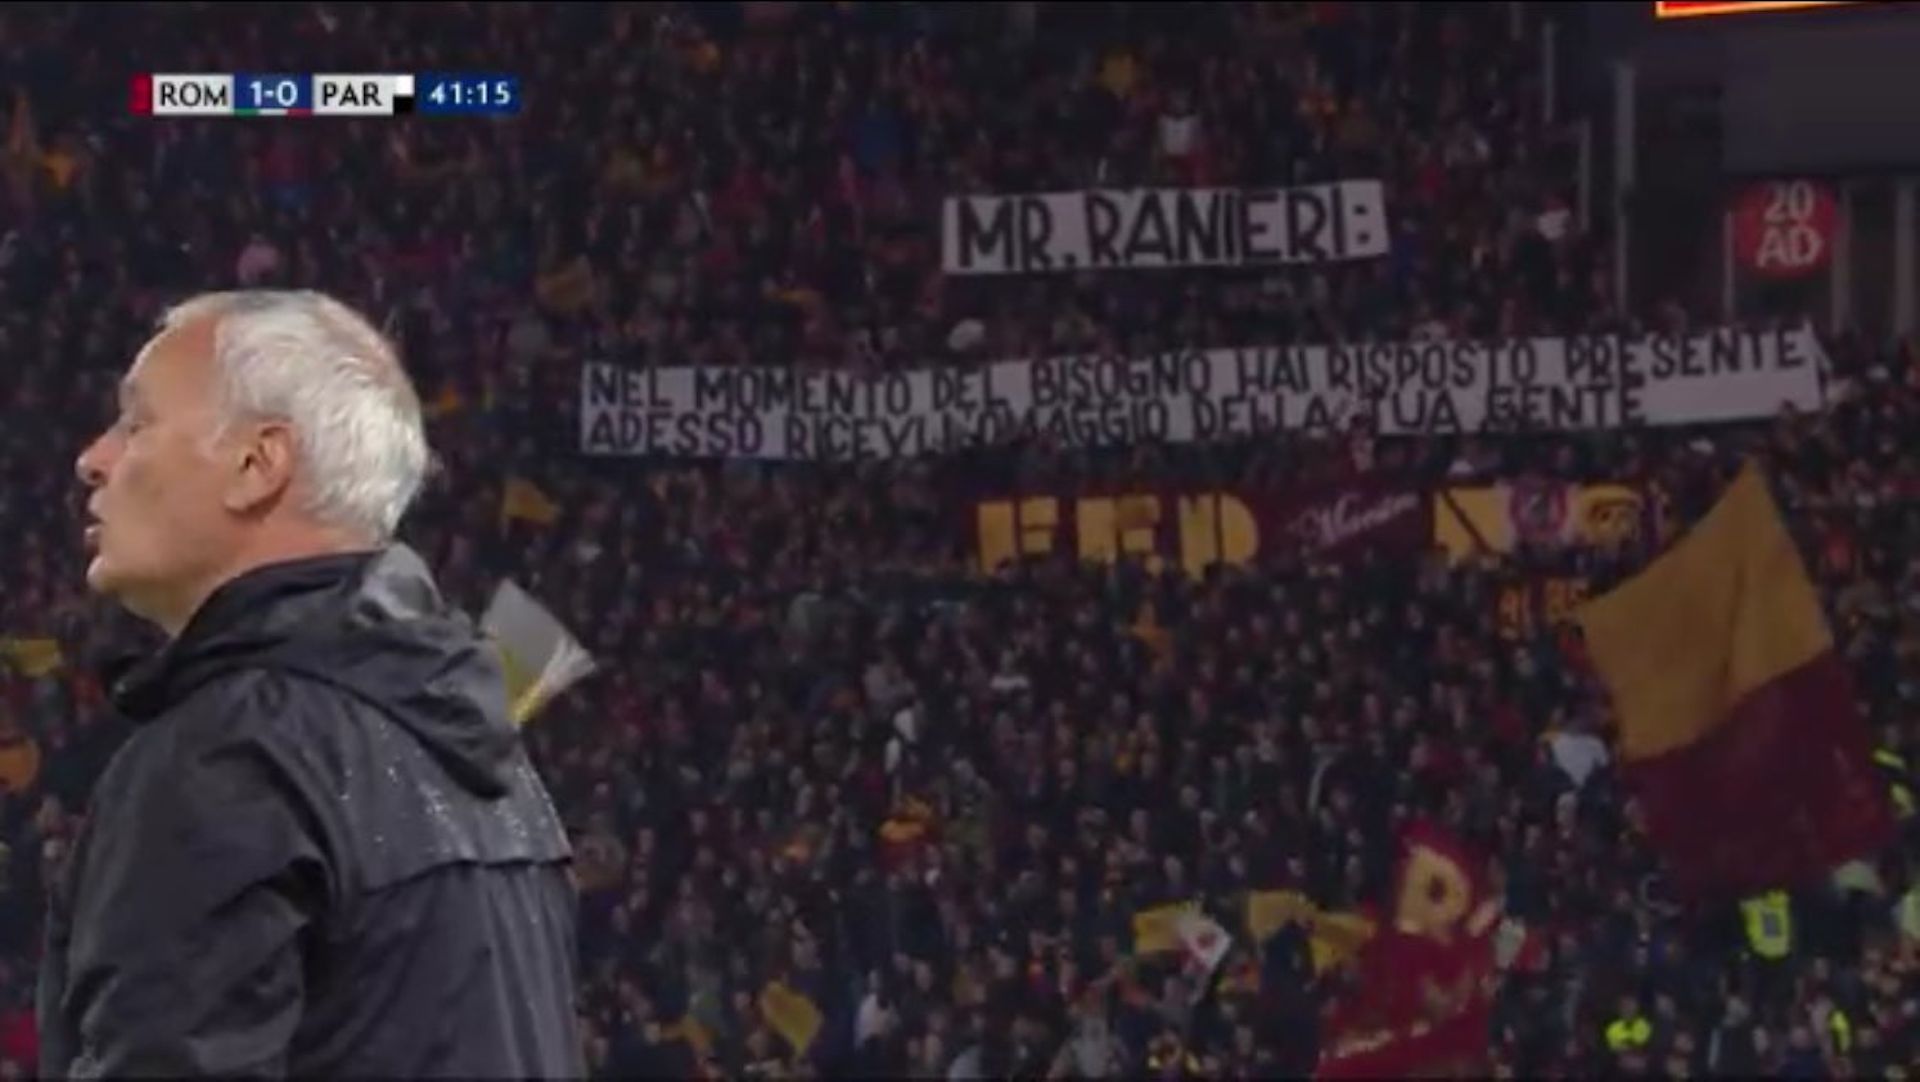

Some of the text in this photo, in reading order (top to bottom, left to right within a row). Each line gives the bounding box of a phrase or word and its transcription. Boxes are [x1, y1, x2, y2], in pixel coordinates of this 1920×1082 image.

[1764, 179, 1814, 222] 20
[1757, 225, 1823, 267] AD
[590, 329, 1806, 422] NEL MOMENTO DEL BISOGNO HAI RISPOSTO PRESENTE
[588, 411, 764, 455] ADESSO
[1479, 384, 1647, 433] GENTE
